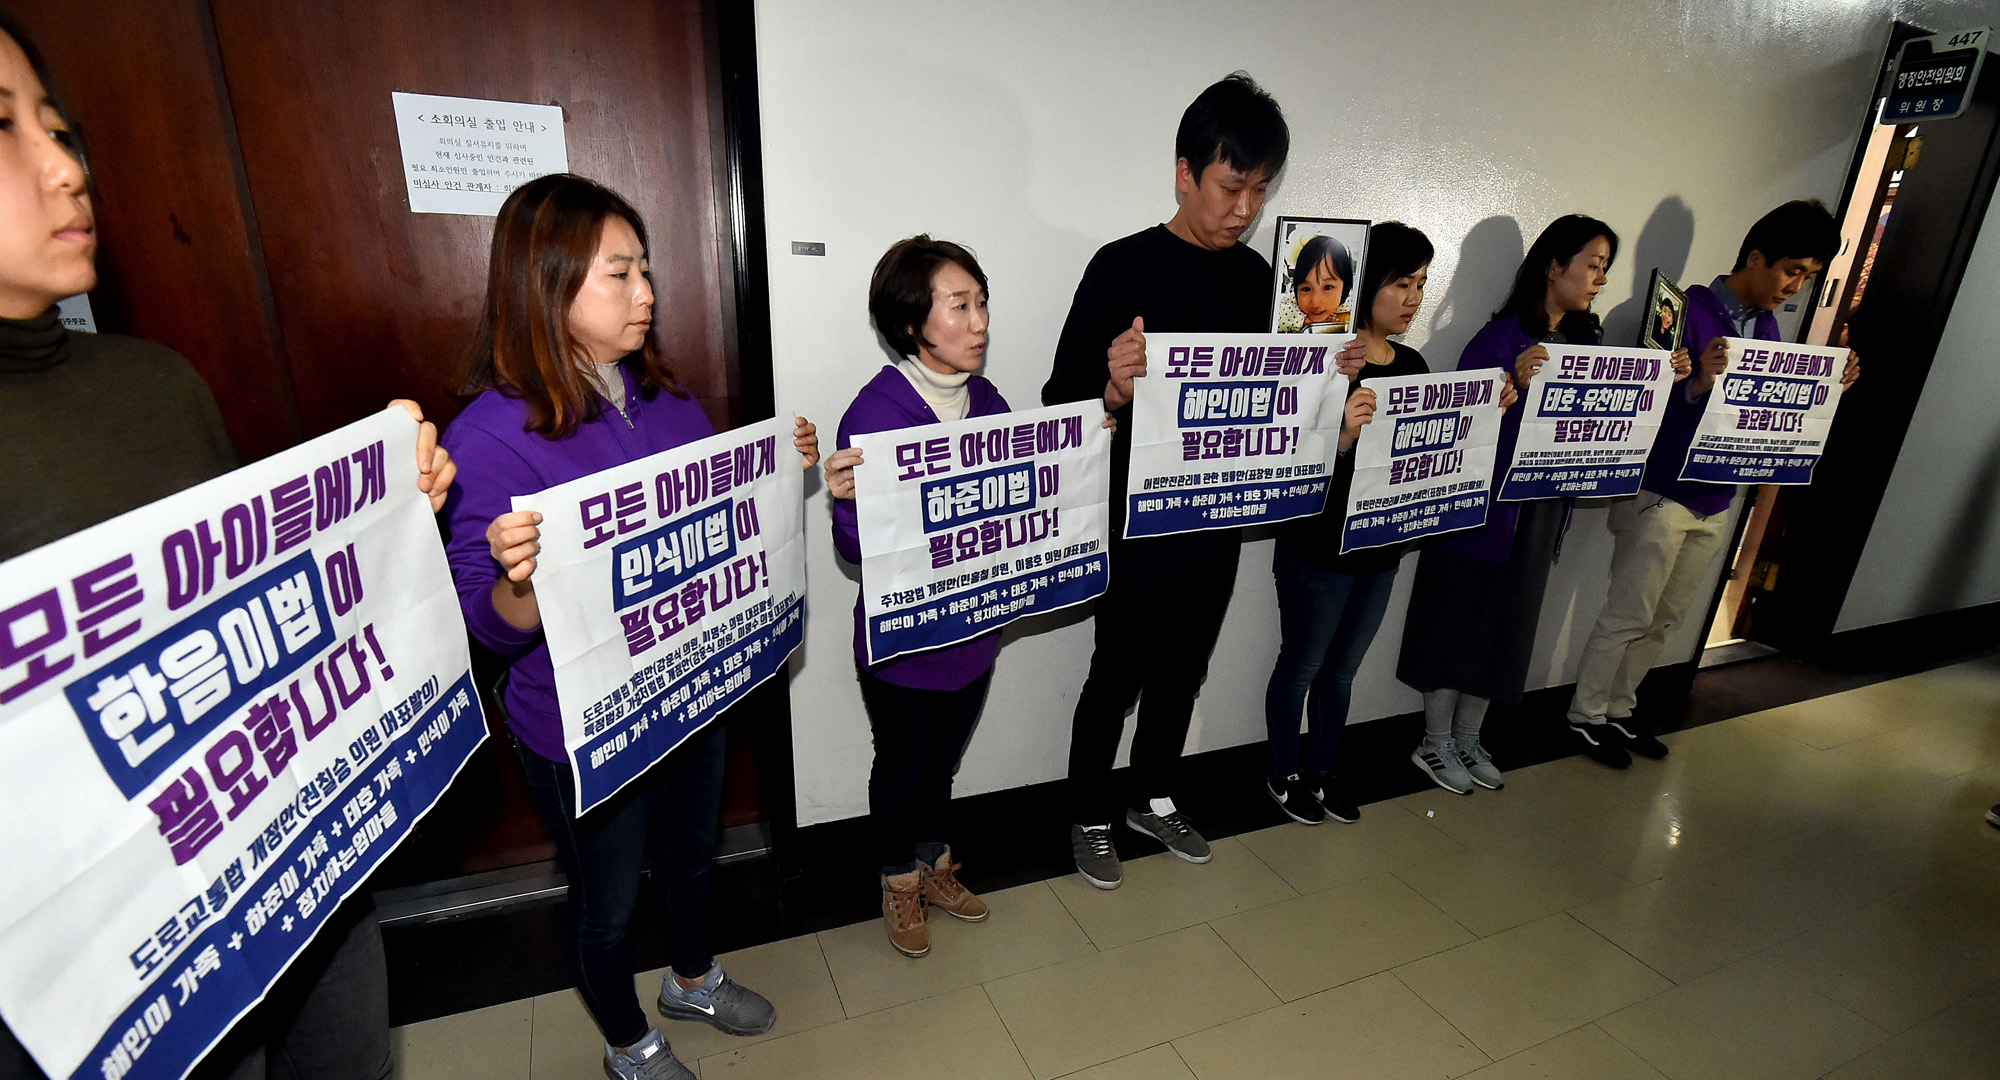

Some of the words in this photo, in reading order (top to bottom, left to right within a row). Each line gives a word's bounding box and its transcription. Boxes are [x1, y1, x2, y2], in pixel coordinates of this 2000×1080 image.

[1947, 30, 1984, 47] 447
[1898, 65, 1967, 89] 행정안전위원회
[431, 114, 477, 128] 소회의실
[484, 118, 506, 131] 출입
[512, 120, 535, 133] 안내
[413, 179, 440, 190] 미심사
[444, 180, 462, 191] 안건
[466, 182, 492, 193] 관계자
[1165, 346, 1214, 378] 모든
[1219, 346, 1328, 377] 아이들에게
[1557, 355, 1590, 380] 모든
[1591, 357, 1661, 381] 아이들에게
[1737, 349, 1769, 372] 모든
[1769, 352, 1835, 377] 아이들에게
[1386, 386, 1419, 415] 모든
[1422, 379, 1493, 411] 아이들에게
[1554, 419, 1633, 443] 필요합니다!
[1736, 409, 1804, 433] 필요합니다!
[896, 437, 951, 481] 모든
[960, 415, 1083, 467] 아이들에게
[1182, 427, 1299, 461] 필요합니다!
[1389, 450, 1464, 485] 필요합니다!
[579, 481, 647, 549] 모든
[655, 435, 776, 519] 아이들에게
[162, 440, 386, 610] 아이들에게
[929, 507, 1059, 569] 필요합니다!
[880, 586, 924, 607] 주차장법
[926, 568, 988, 596] 개정안(민홍철
[991, 561, 1013, 578] 의원,
[1015, 554, 1042, 571] 이용호
[1044, 548, 1061, 564] 의원
[1063, 538, 1099, 558] 대표발의)
[620, 551, 769, 657] 필요합니다!
[879, 614, 914, 633] 해인이
[916, 608, 937, 625] 가족
[948, 595, 978, 614] 하준이
[980, 588, 997, 605] 가족
[1010, 581, 1027, 597] 태호
[1029, 575, 1047, 591] 가족
[1057, 565, 1083, 582] 민식이
[1084, 560, 1100, 575] 가족
[973, 593, 1035, 623] 정치하는엄마들
[148, 623, 394, 866] 필요합니다!
[130, 857, 246, 980] 도로교통법
[247, 757, 350, 870] 개정안(권칠승
[348, 724, 382, 767] 의원
[379, 674, 438, 738] 대표발의)
[172, 943, 220, 1006] 가족
[244, 865, 299, 935] 하준이
[297, 829, 328, 878] 가족
[342, 784, 376, 828] 태호
[373, 756, 402, 797] 가족
[417, 709, 450, 756] 민식이
[447, 687, 469, 722] 가족
[295, 799, 396, 916] 정치하는엄마들
